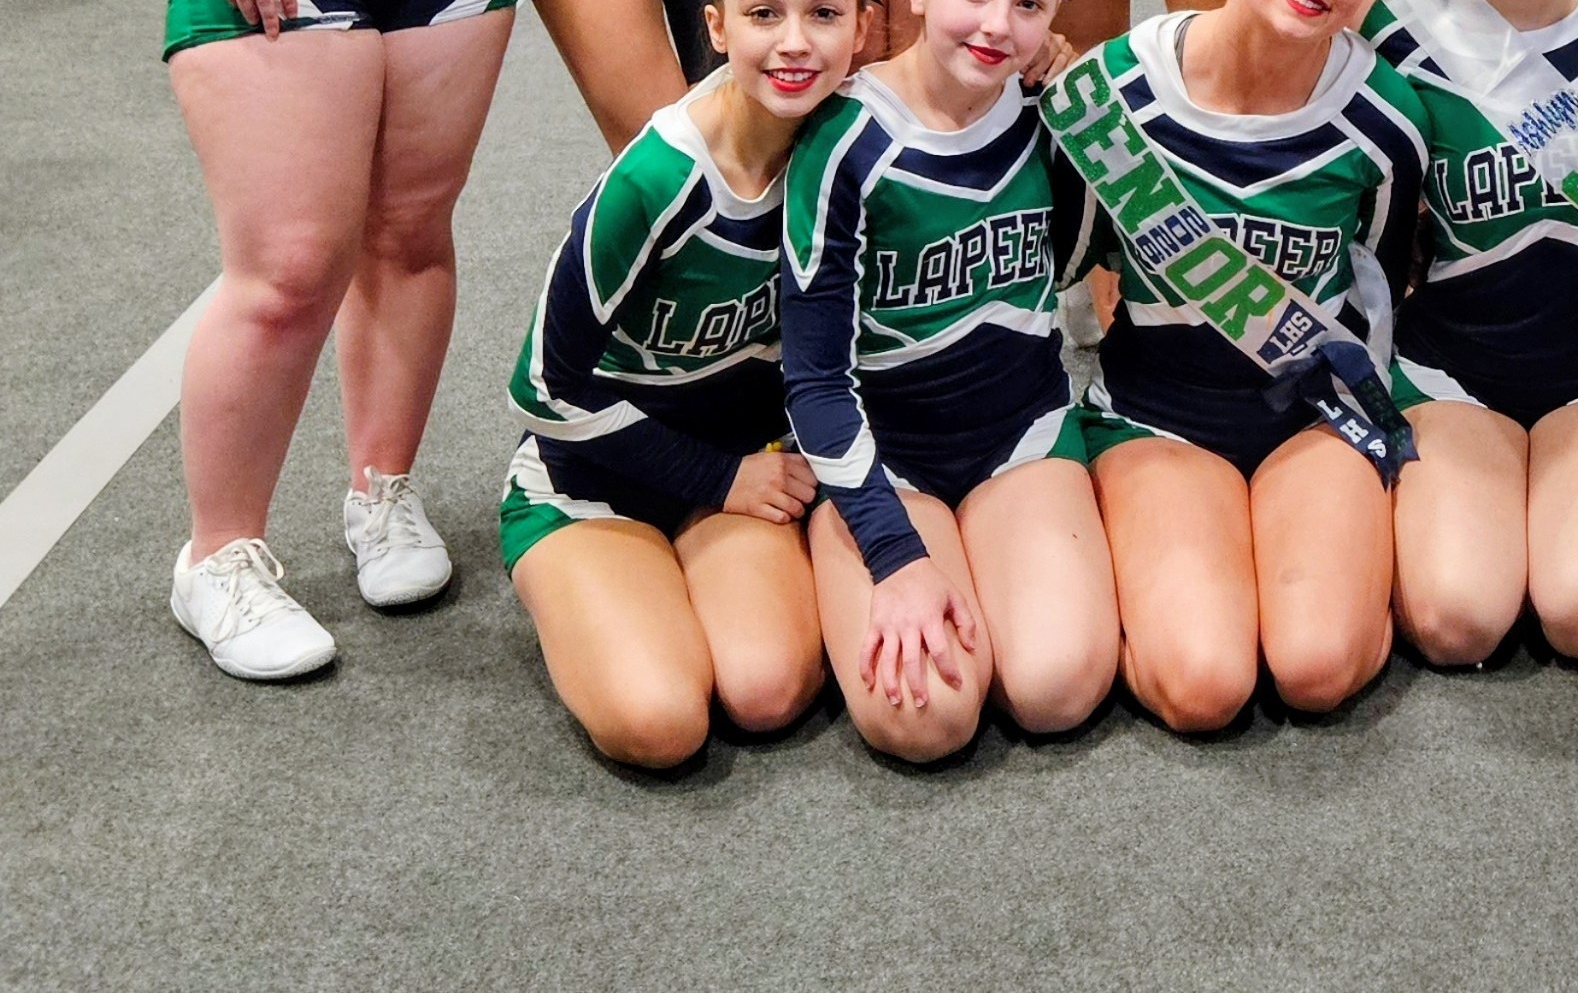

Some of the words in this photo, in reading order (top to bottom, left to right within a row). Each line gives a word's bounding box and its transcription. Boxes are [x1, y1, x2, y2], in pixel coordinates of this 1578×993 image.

[643, 273, 781, 358] LAP
[1269, 311, 1313, 354] LHS
[1317, 399, 1387, 458] LHS
